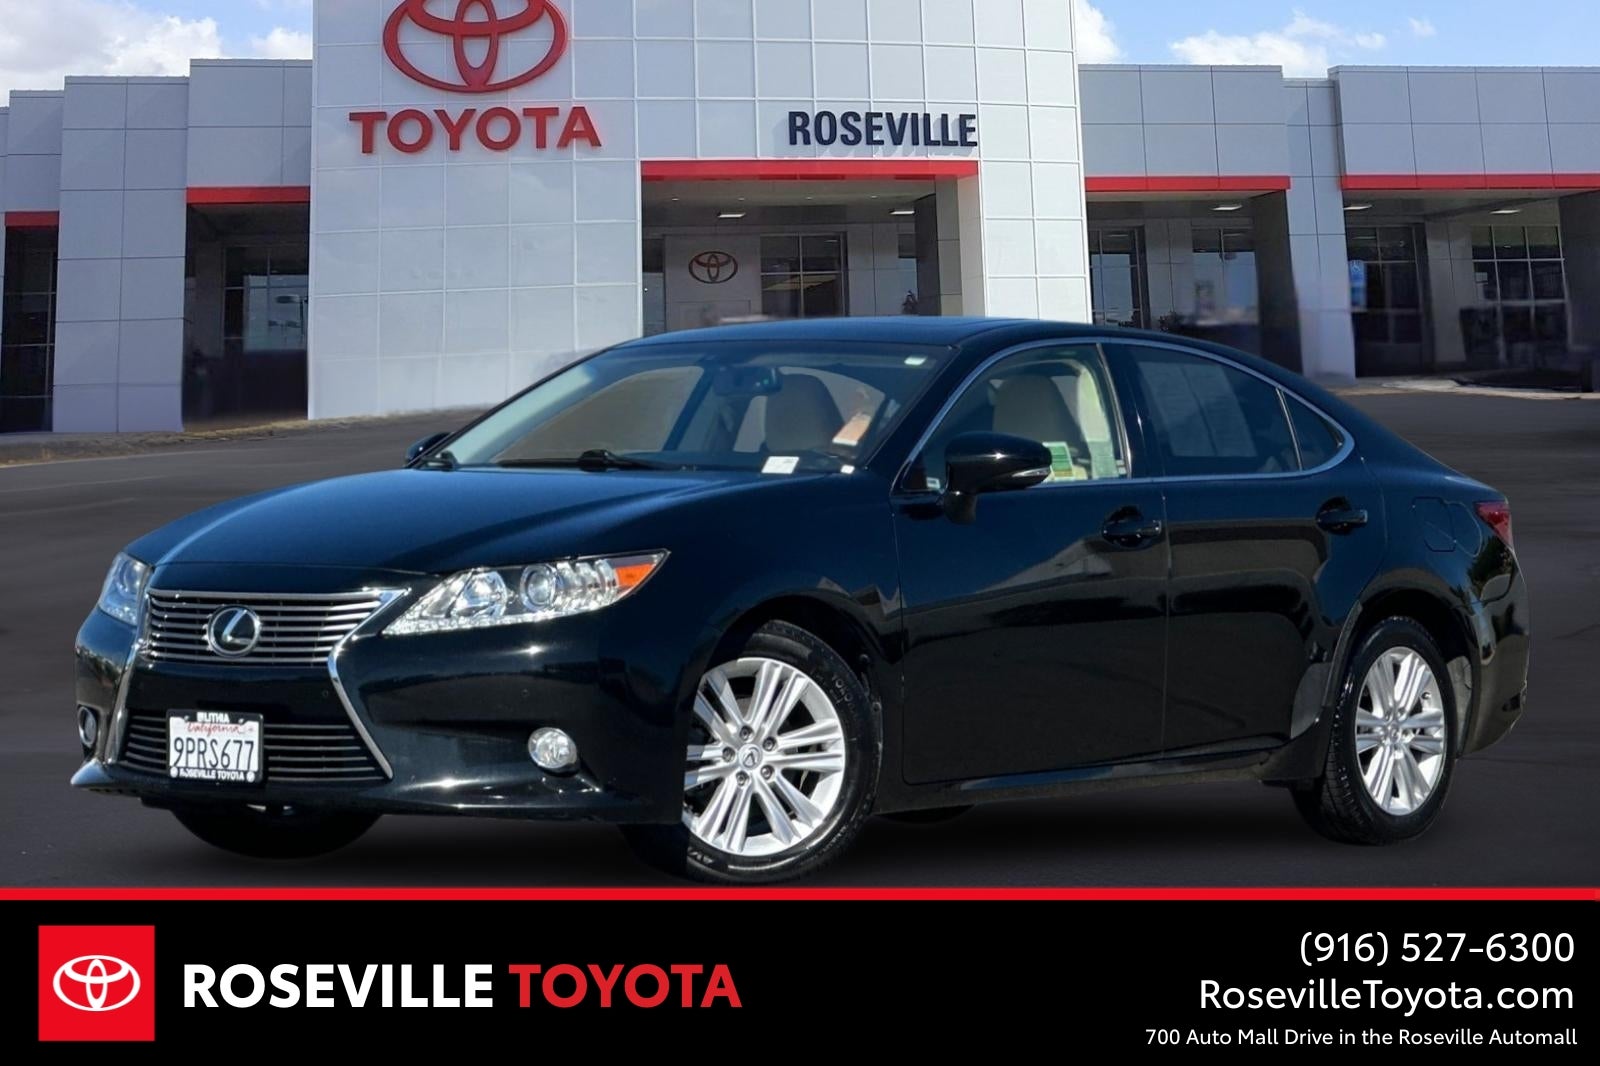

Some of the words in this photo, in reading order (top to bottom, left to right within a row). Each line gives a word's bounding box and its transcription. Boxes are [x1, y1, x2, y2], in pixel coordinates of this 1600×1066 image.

[349, 106, 602, 154] TOYOTA
[788, 110, 978, 148] ROSEVILLE
[173, 737, 254, 771] 9PRS677
[217, 770, 245, 781] TOYOTA
